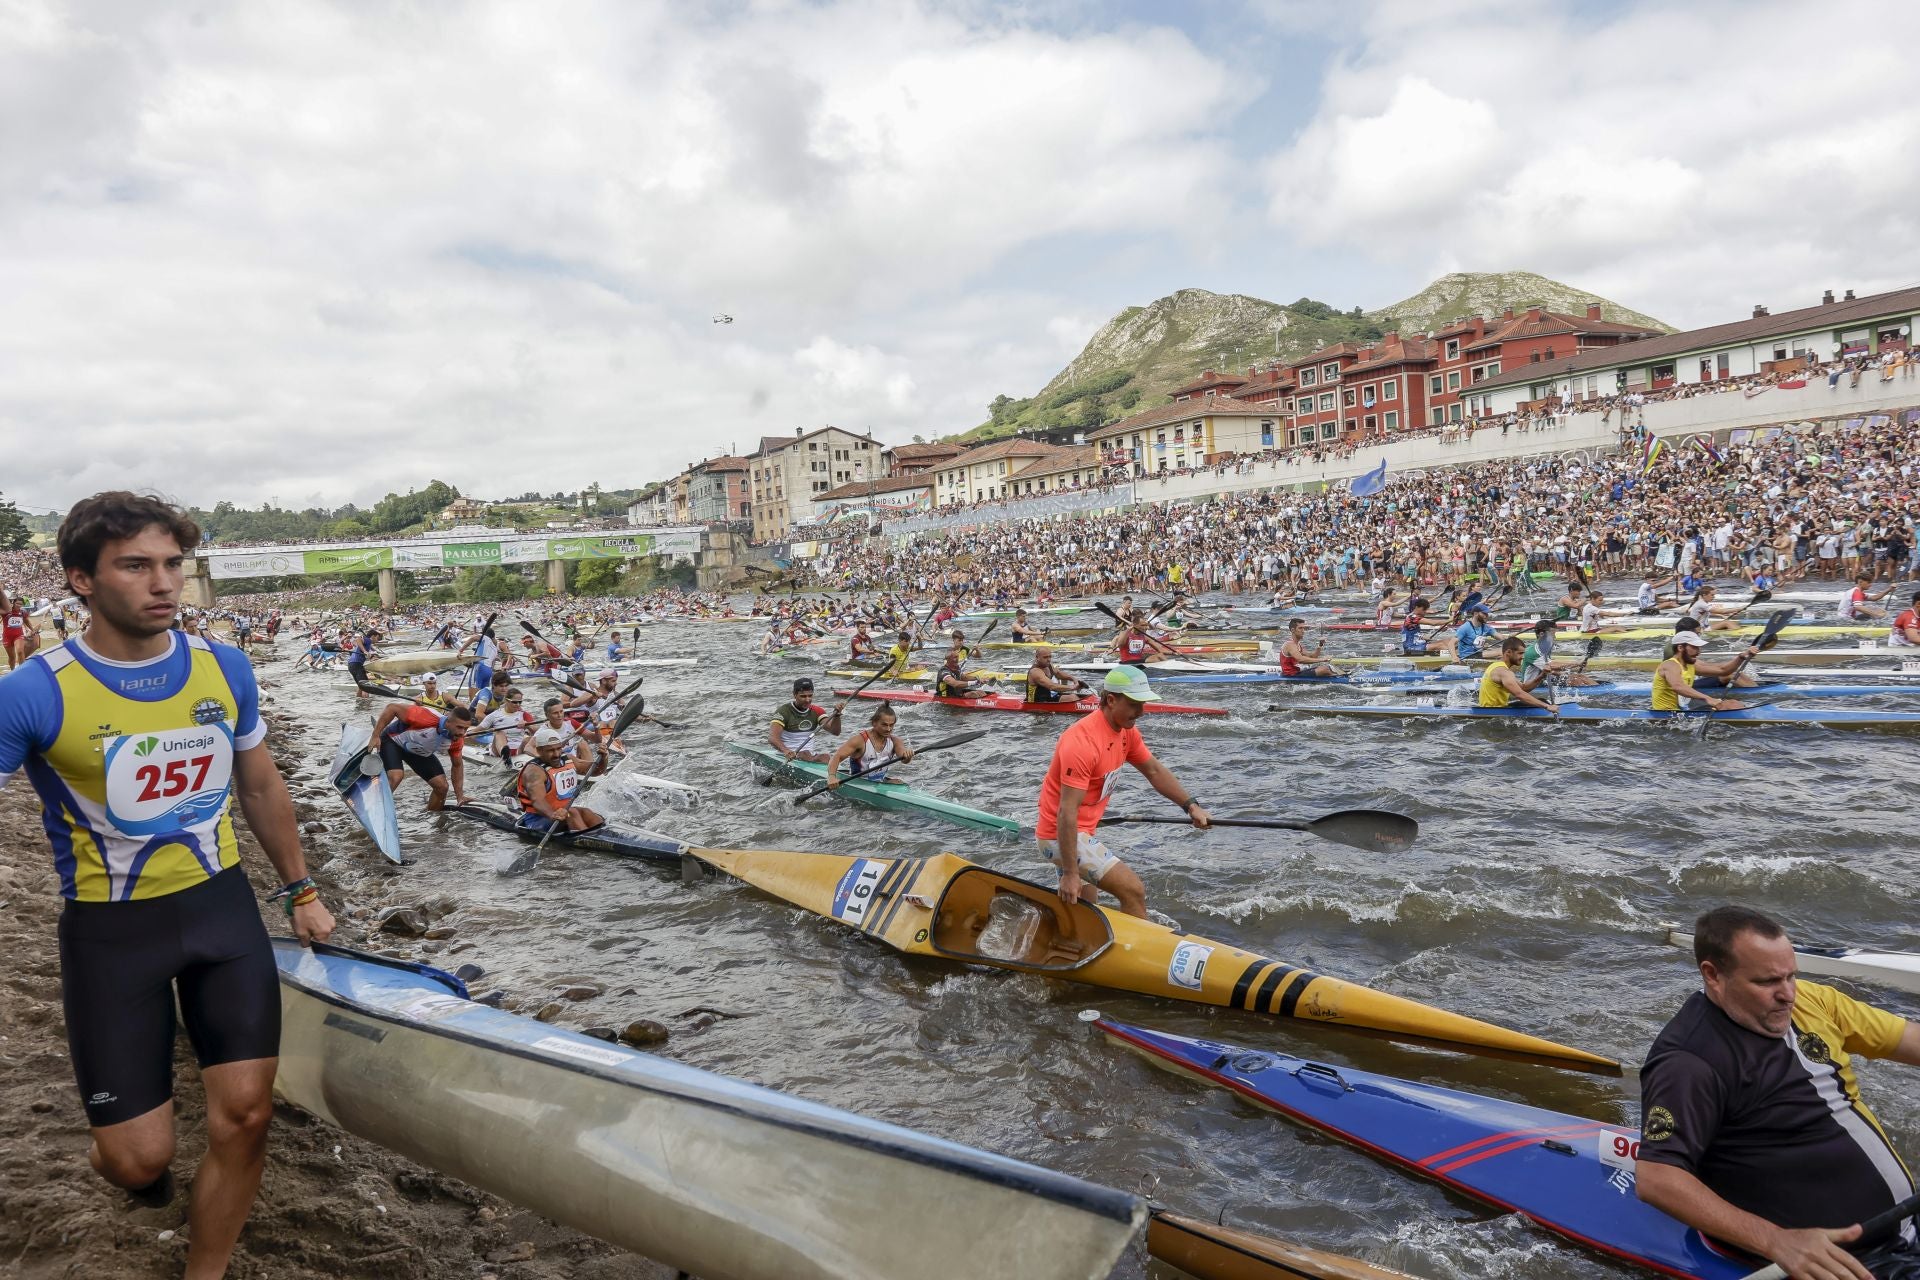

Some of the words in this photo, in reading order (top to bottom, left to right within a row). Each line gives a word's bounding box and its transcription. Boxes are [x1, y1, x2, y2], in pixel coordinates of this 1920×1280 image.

[224, 561, 268, 570] AMBILAMP
[120, 673, 168, 691] land
[163, 735, 215, 753] Unicaja
[135, 753, 215, 803] 257
[561, 776, 575, 790] 130
